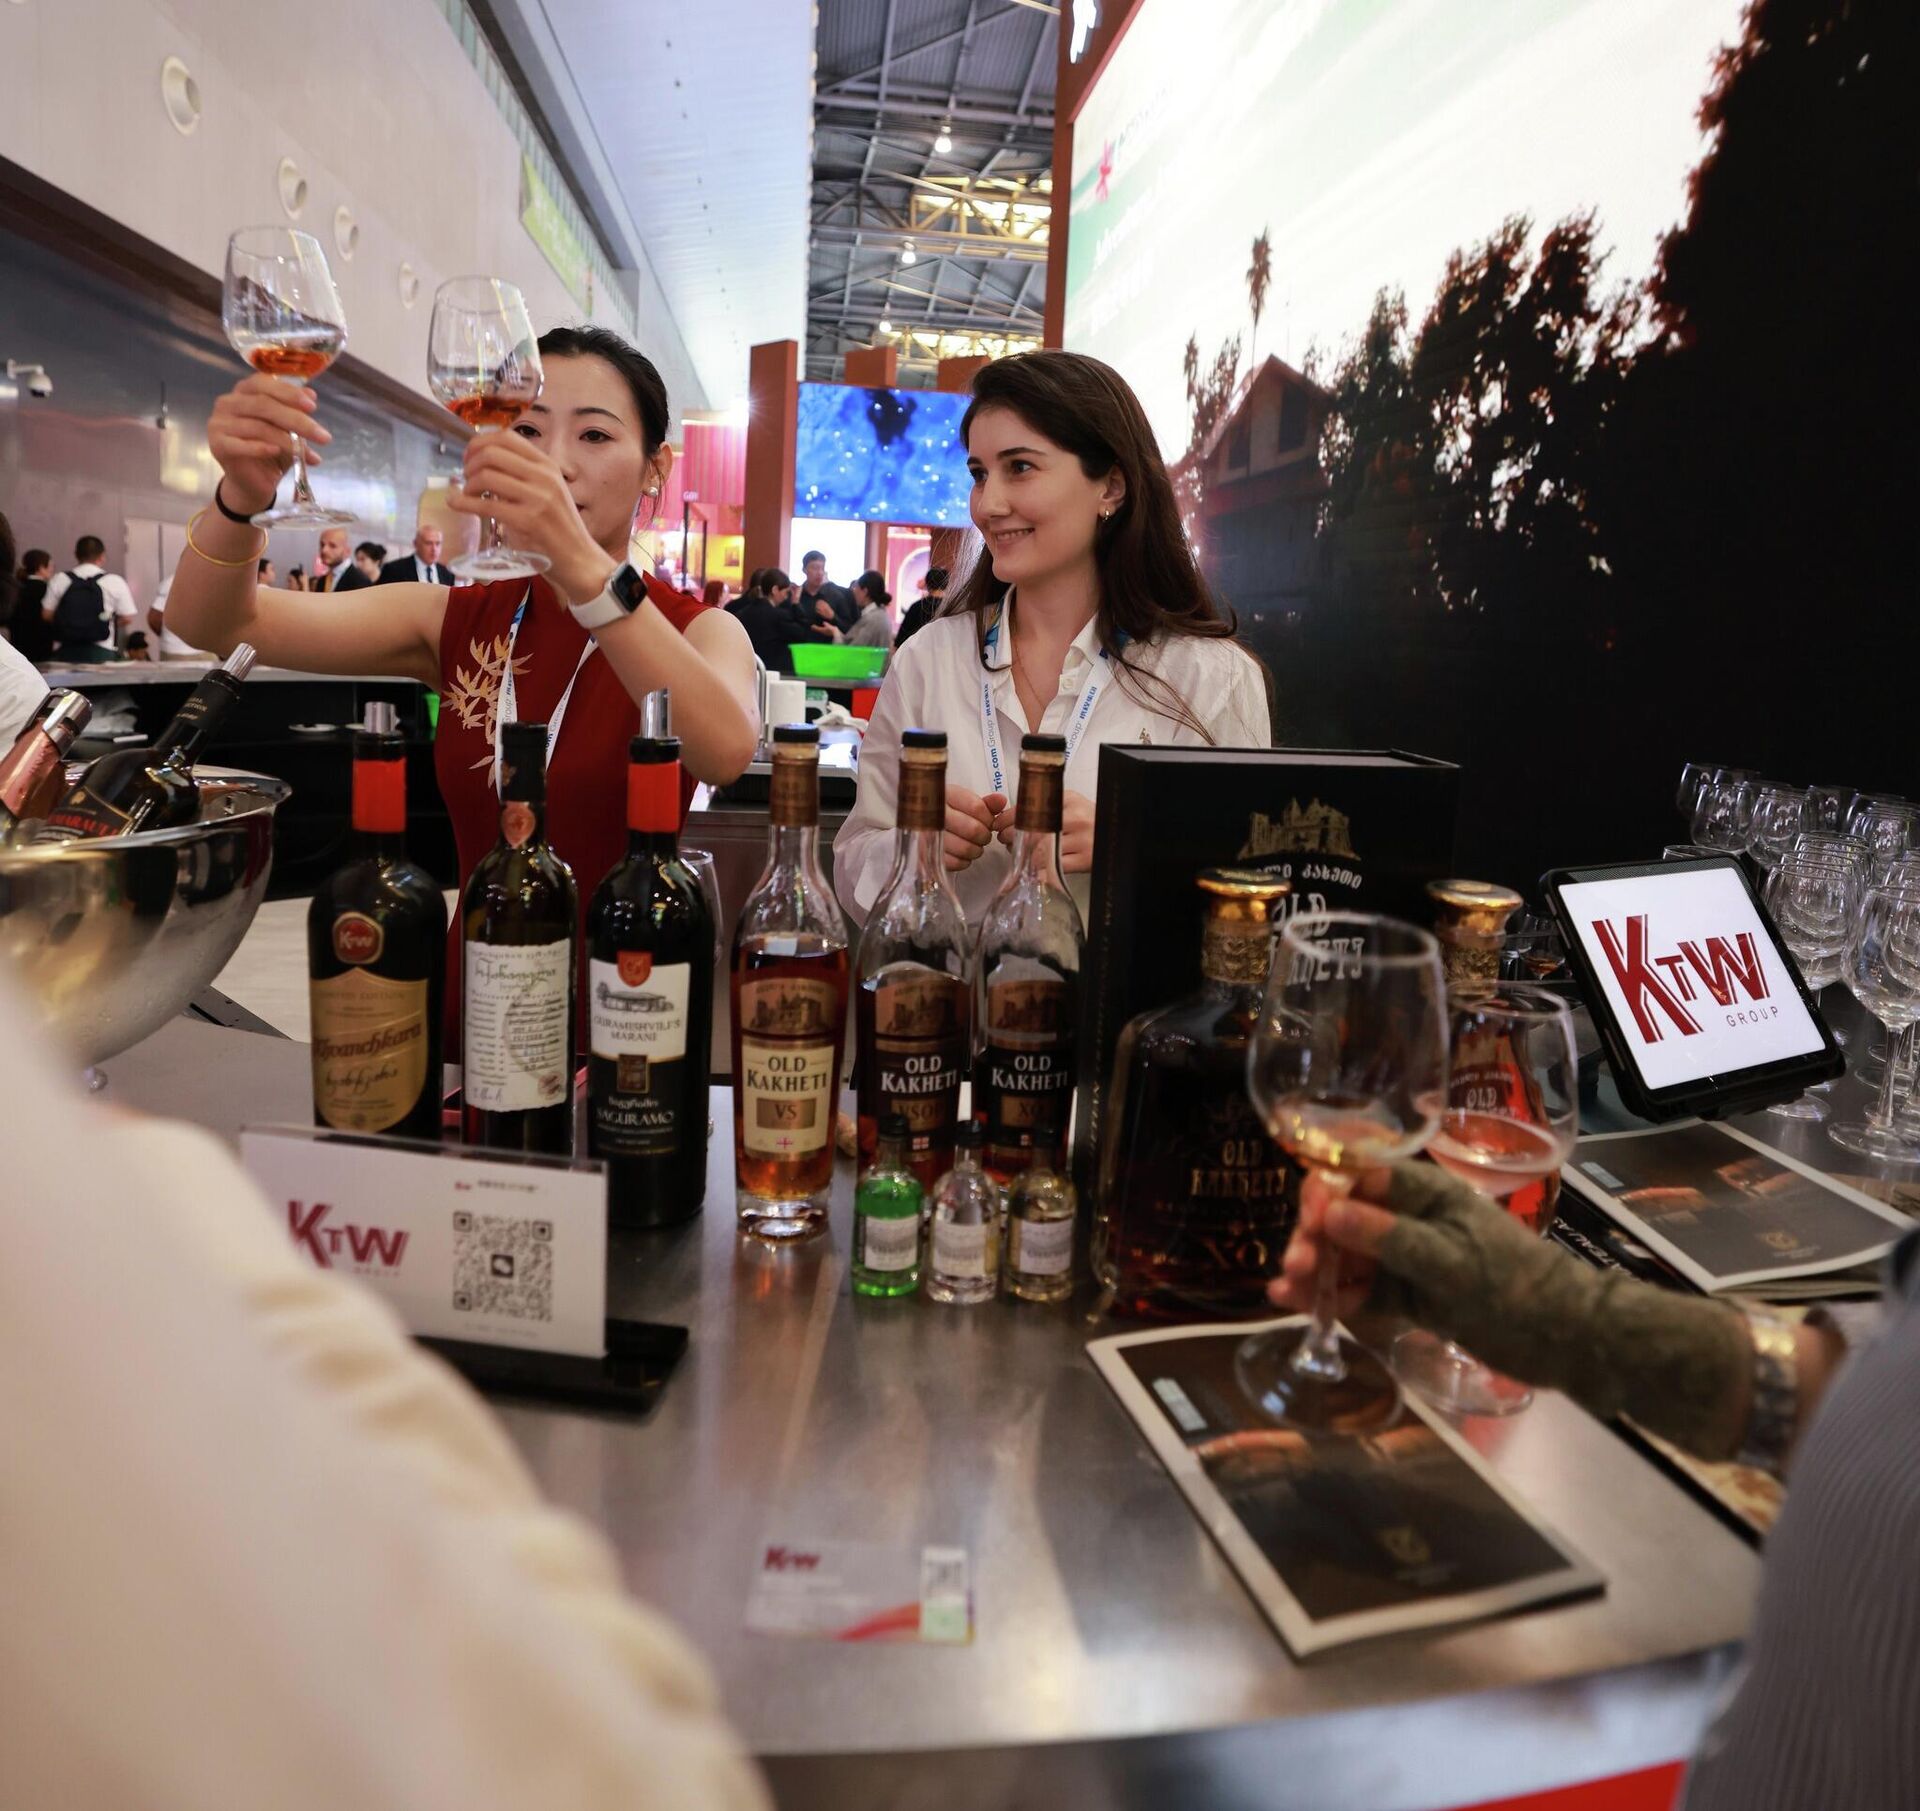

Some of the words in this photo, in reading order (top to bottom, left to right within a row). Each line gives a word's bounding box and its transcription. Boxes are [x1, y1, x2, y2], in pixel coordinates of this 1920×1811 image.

[986, 720, 995, 748] Group
[1068, 721, 1082, 750] Group
[991, 748, 1003, 791] Trip.com
[1592, 914, 1770, 1044] KTW
[1726, 1006, 1779, 1027] GROUP
[768, 1056, 807, 1072] OLD
[904, 1056, 942, 1074] OLD
[1014, 1056, 1051, 1072] OLD
[747, 1069, 827, 1092] KAKHETI
[881, 1069, 957, 1093] KAKHETI
[992, 1068, 1068, 1091] KAKHETI
[1467, 1086, 1498, 1110] OLD
[597, 1107, 674, 1127] SAGURAMO
[775, 1103, 798, 1120] VS
[287, 1200, 411, 1269] KTW
